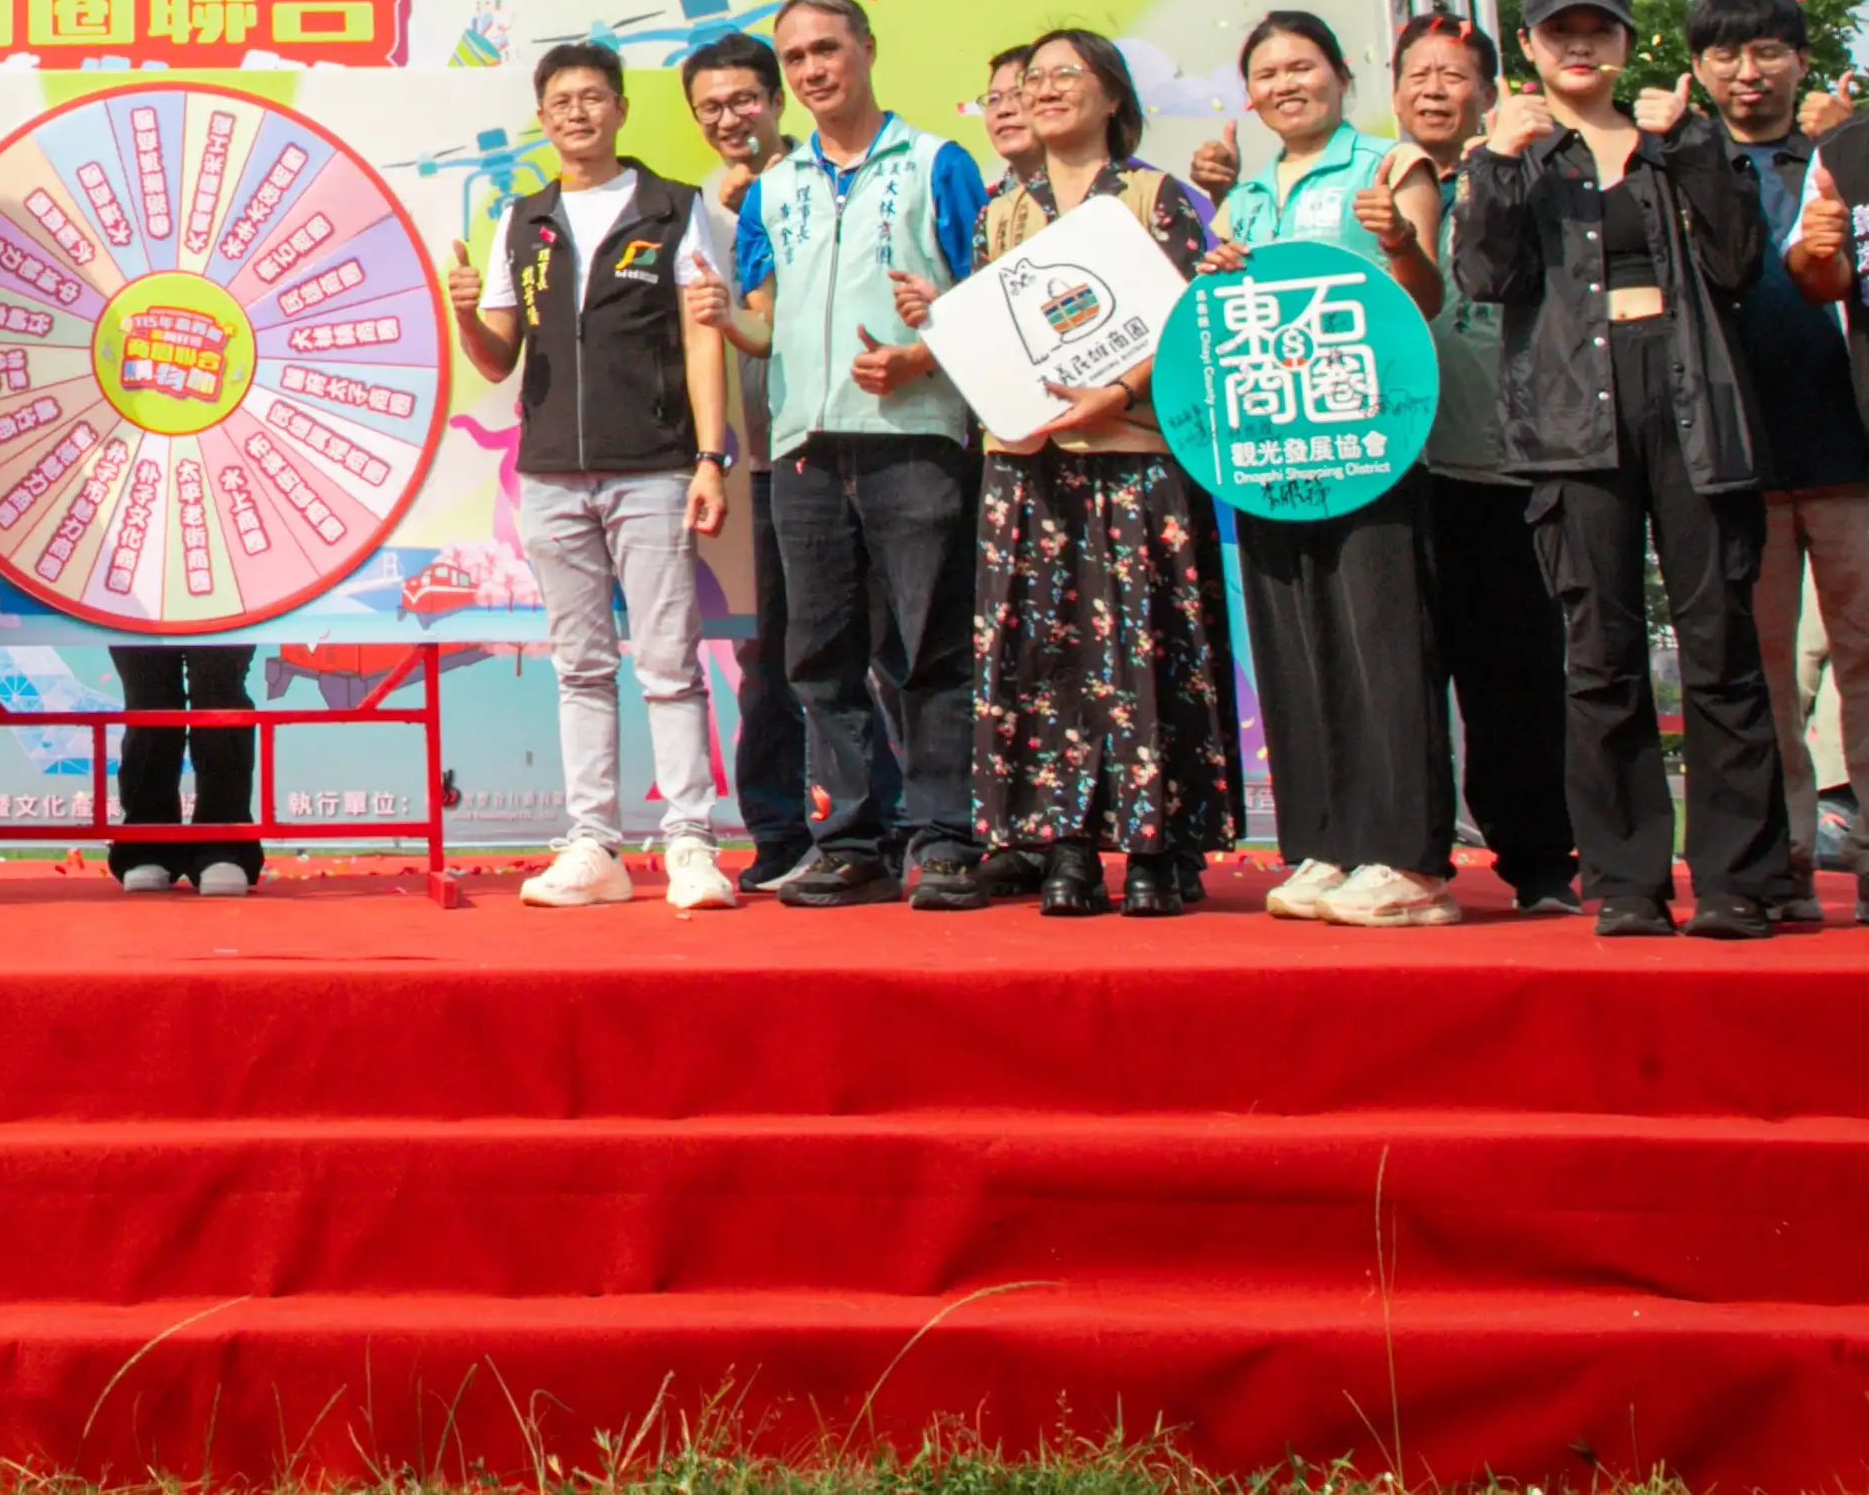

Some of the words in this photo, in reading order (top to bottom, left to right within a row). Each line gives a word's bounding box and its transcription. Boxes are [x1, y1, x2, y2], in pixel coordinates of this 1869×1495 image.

[1219, 345, 1379, 429] 商圈
[1231, 431, 1388, 467] 觀光發展協會
[108, 461, 158, 591] 朴子文化商圈
[178, 461, 210, 592] 太平老街商圈
[222, 468, 269, 553] 水上商圈
